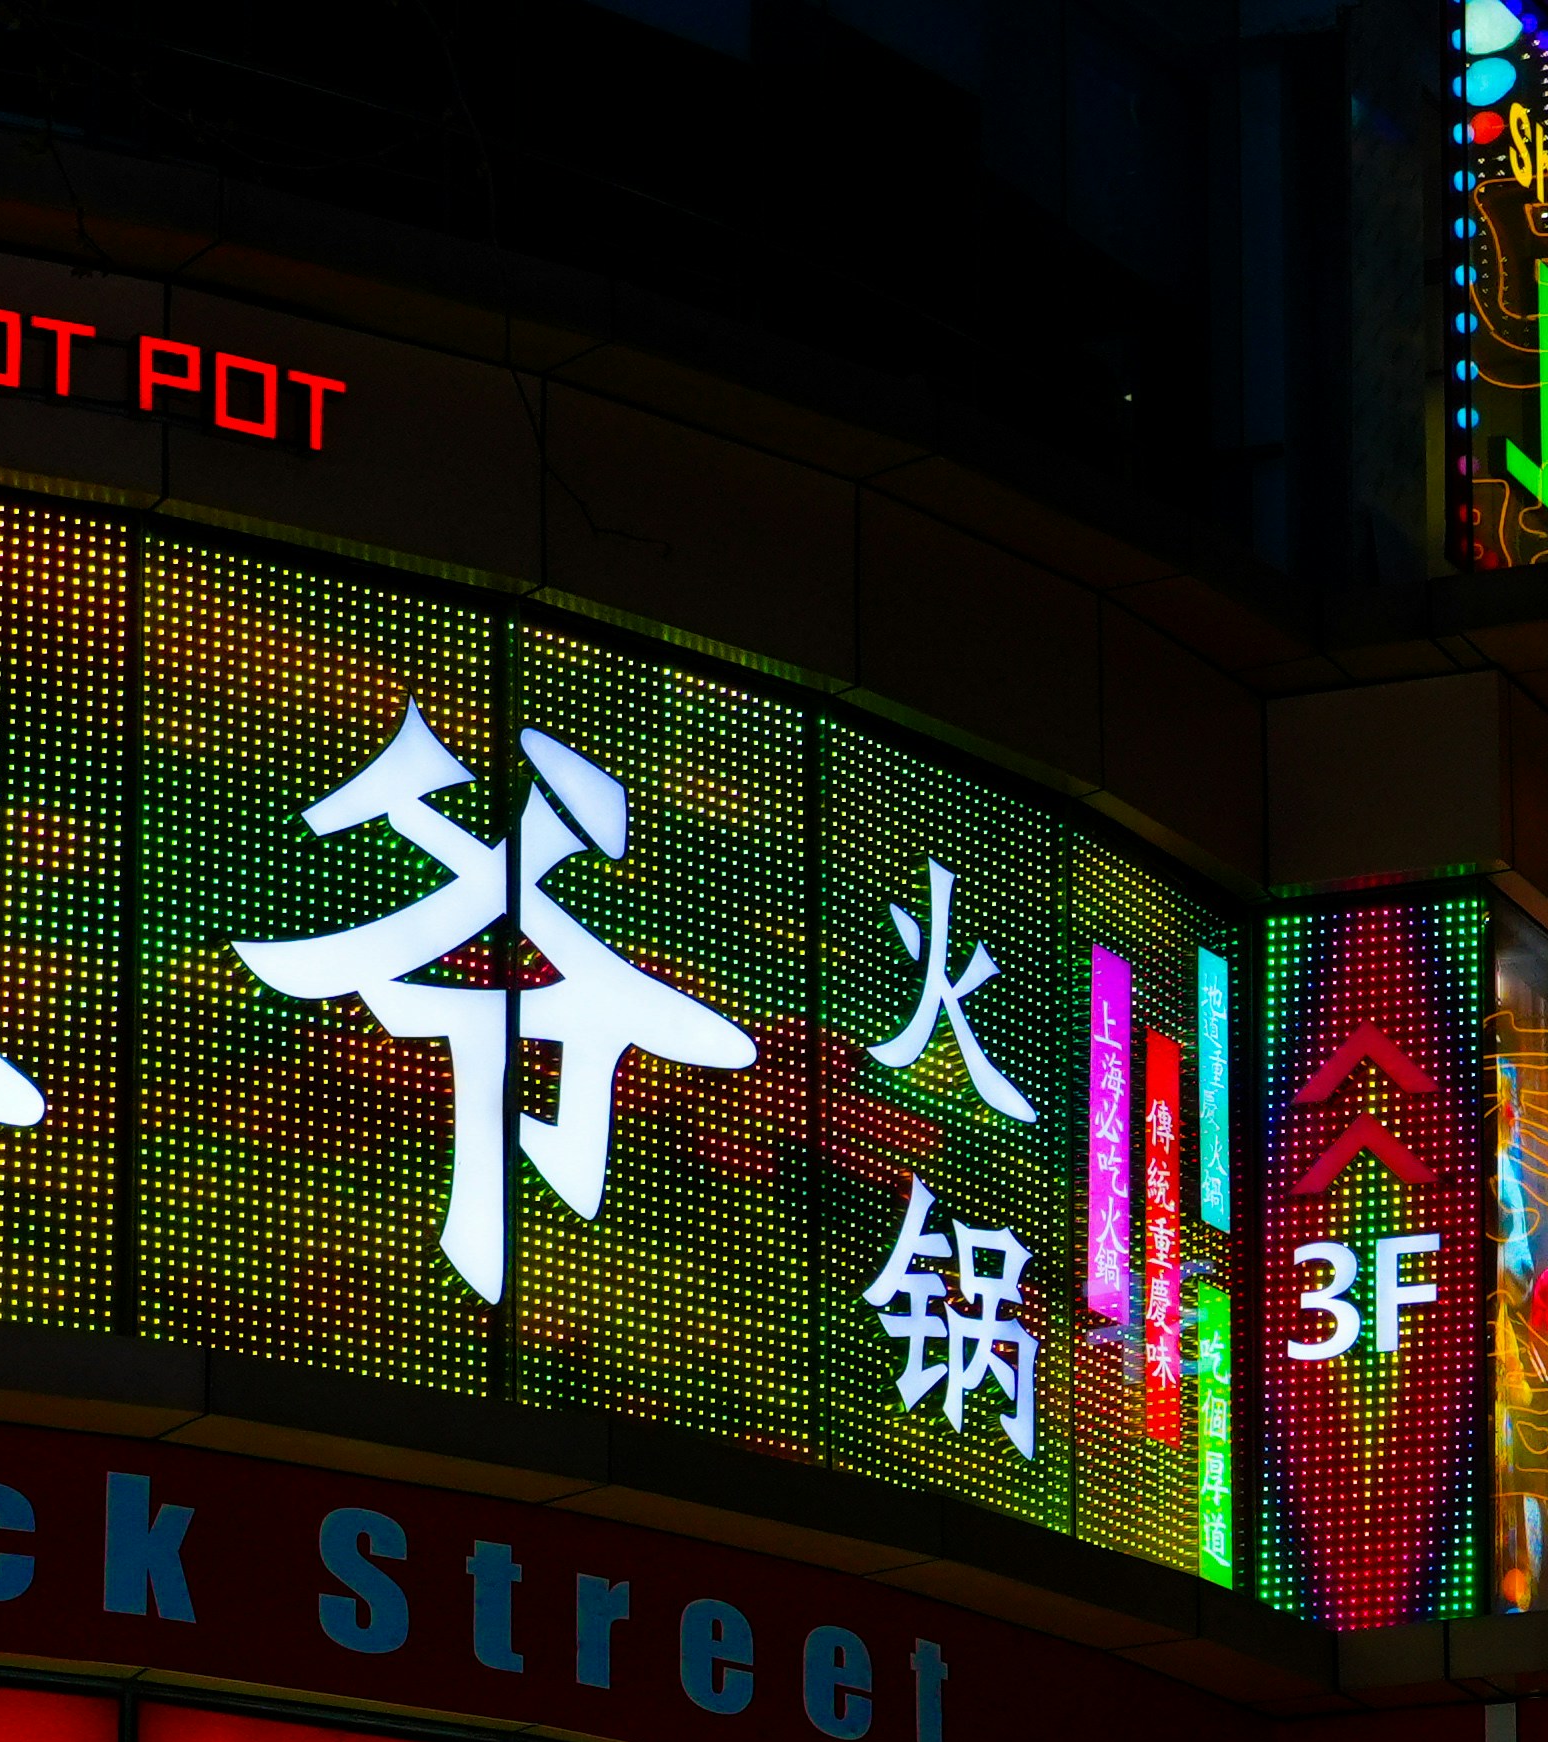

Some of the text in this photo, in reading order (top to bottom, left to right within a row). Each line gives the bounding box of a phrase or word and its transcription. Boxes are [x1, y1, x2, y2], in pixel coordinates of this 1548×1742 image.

[138, 335, 348, 451] POT
[861, 856, 1037, 1460] 火锅
[1286, 1232, 1441, 1362] 3F
